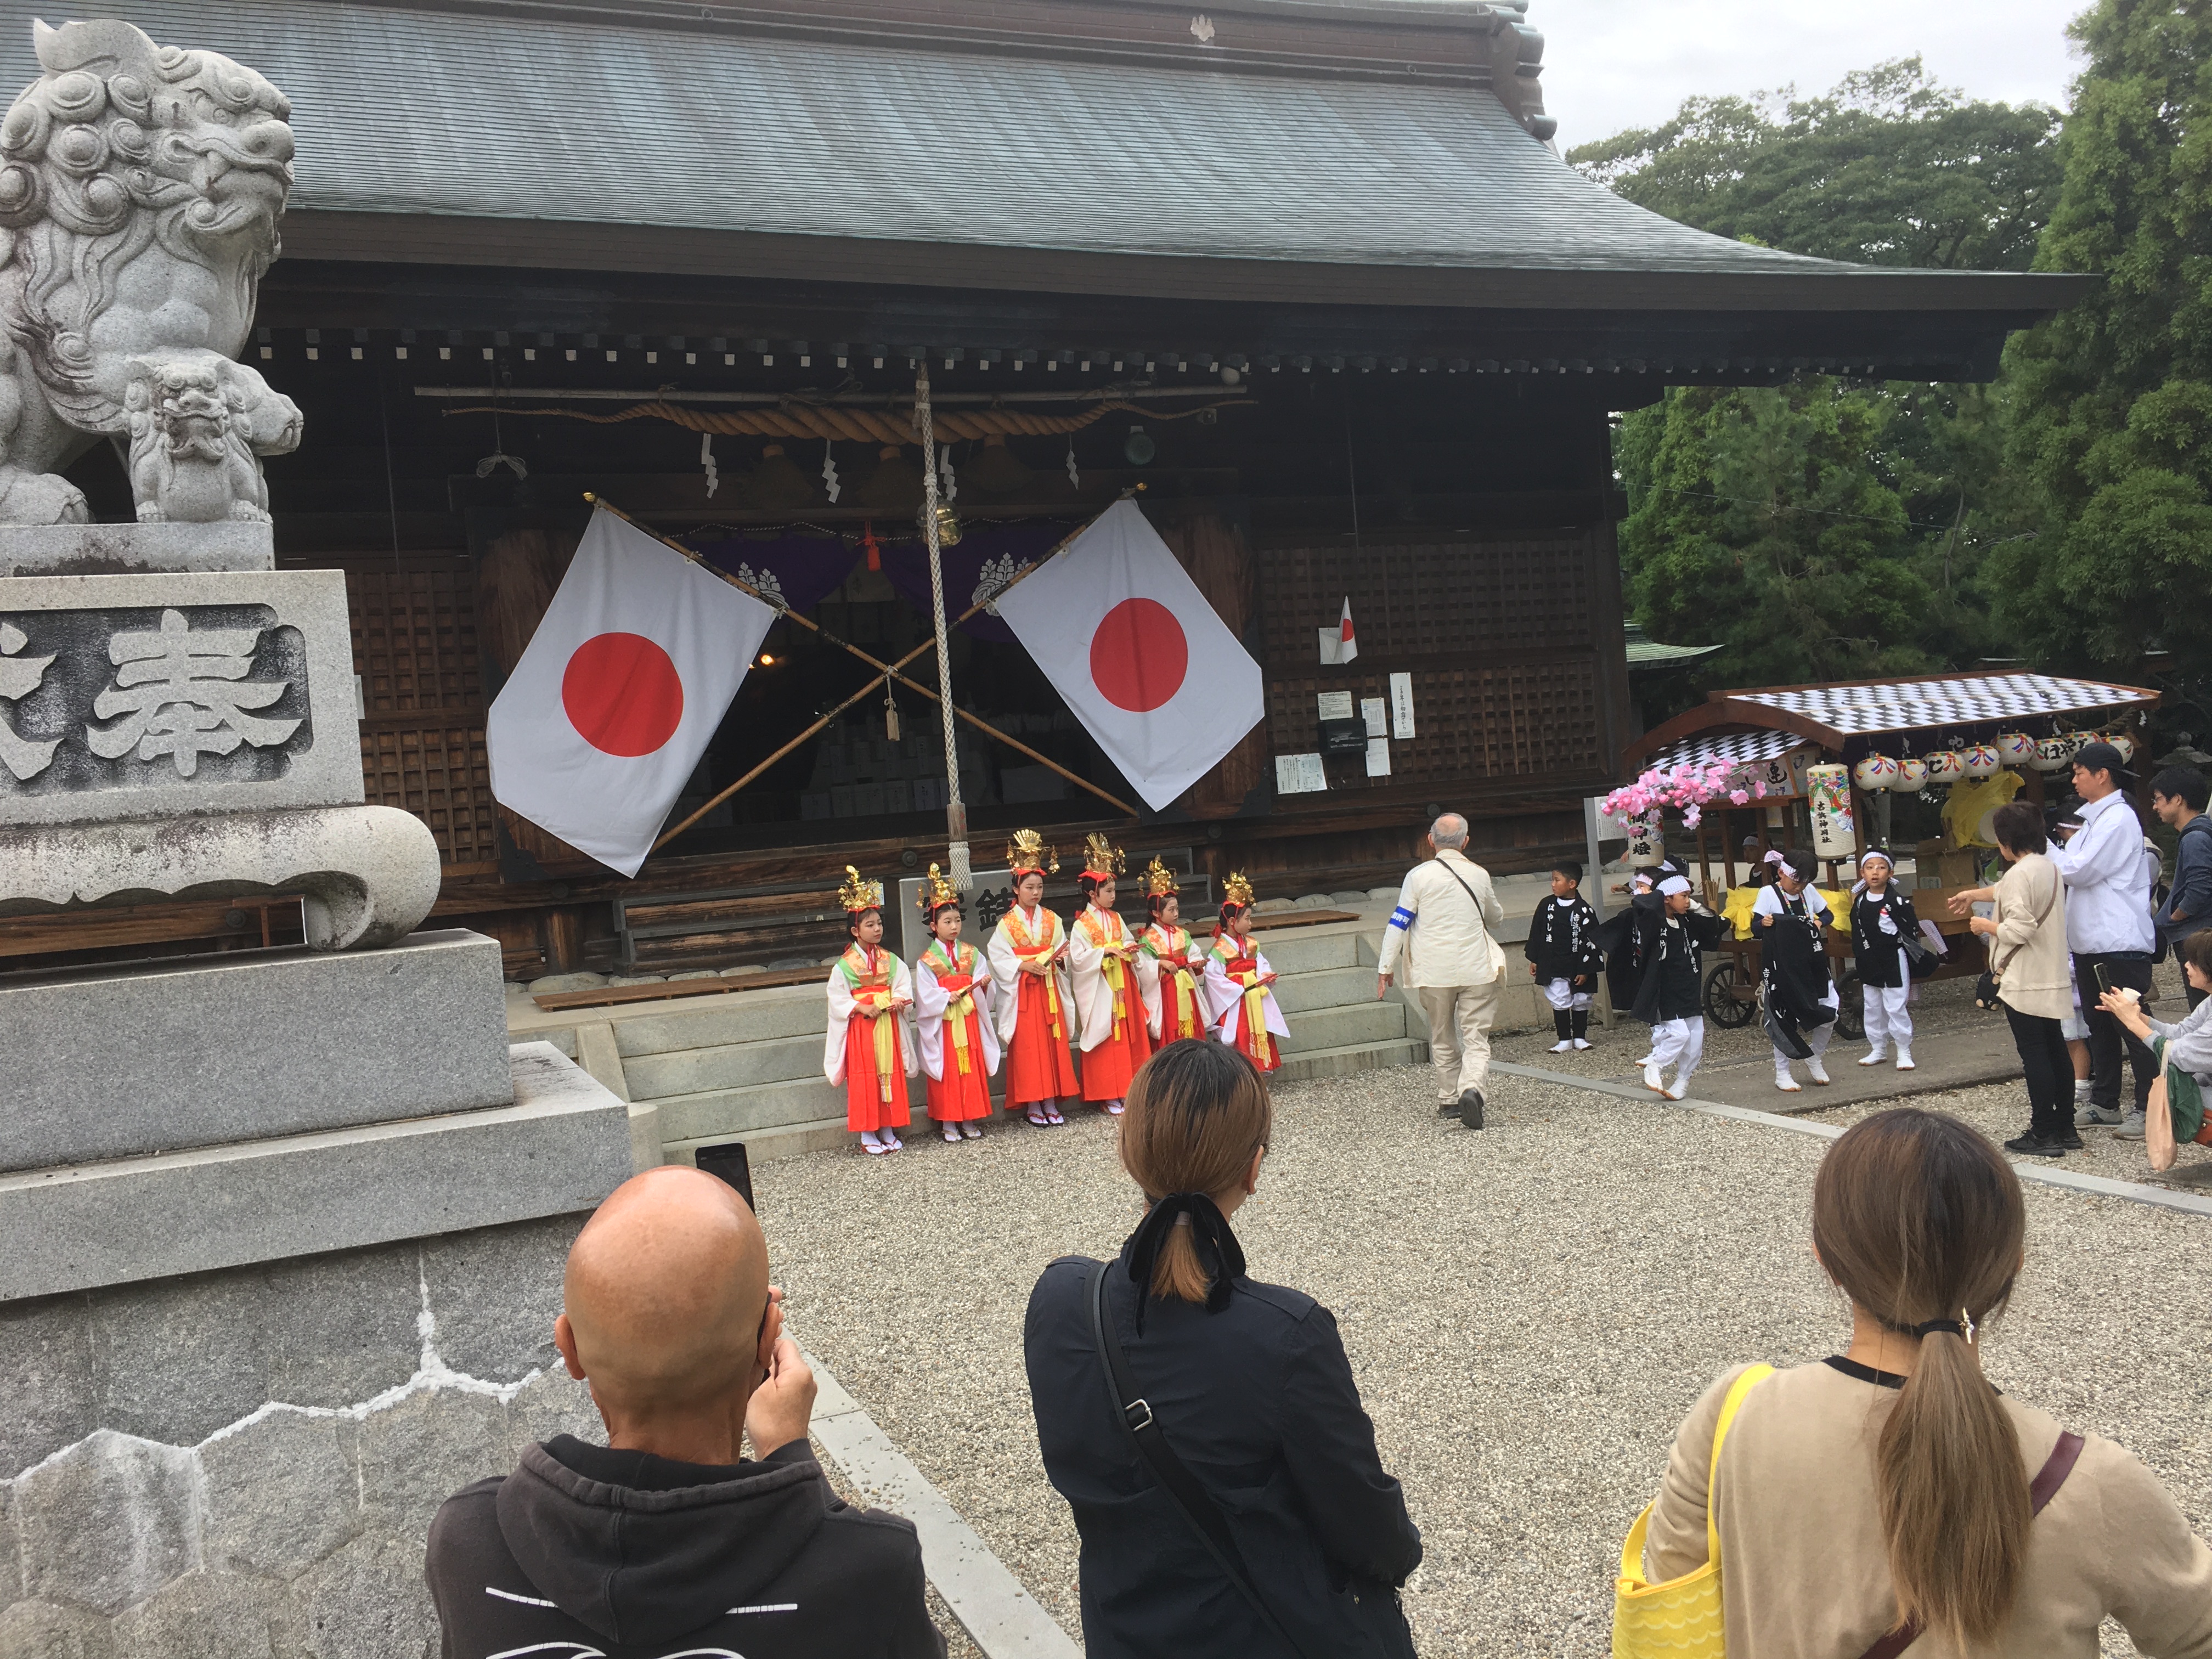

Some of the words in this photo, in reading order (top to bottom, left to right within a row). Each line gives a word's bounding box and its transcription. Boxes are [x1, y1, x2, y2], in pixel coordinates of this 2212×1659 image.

[0, 609, 306, 779] 奉
[1545, 904, 1555, 943] はやし連
